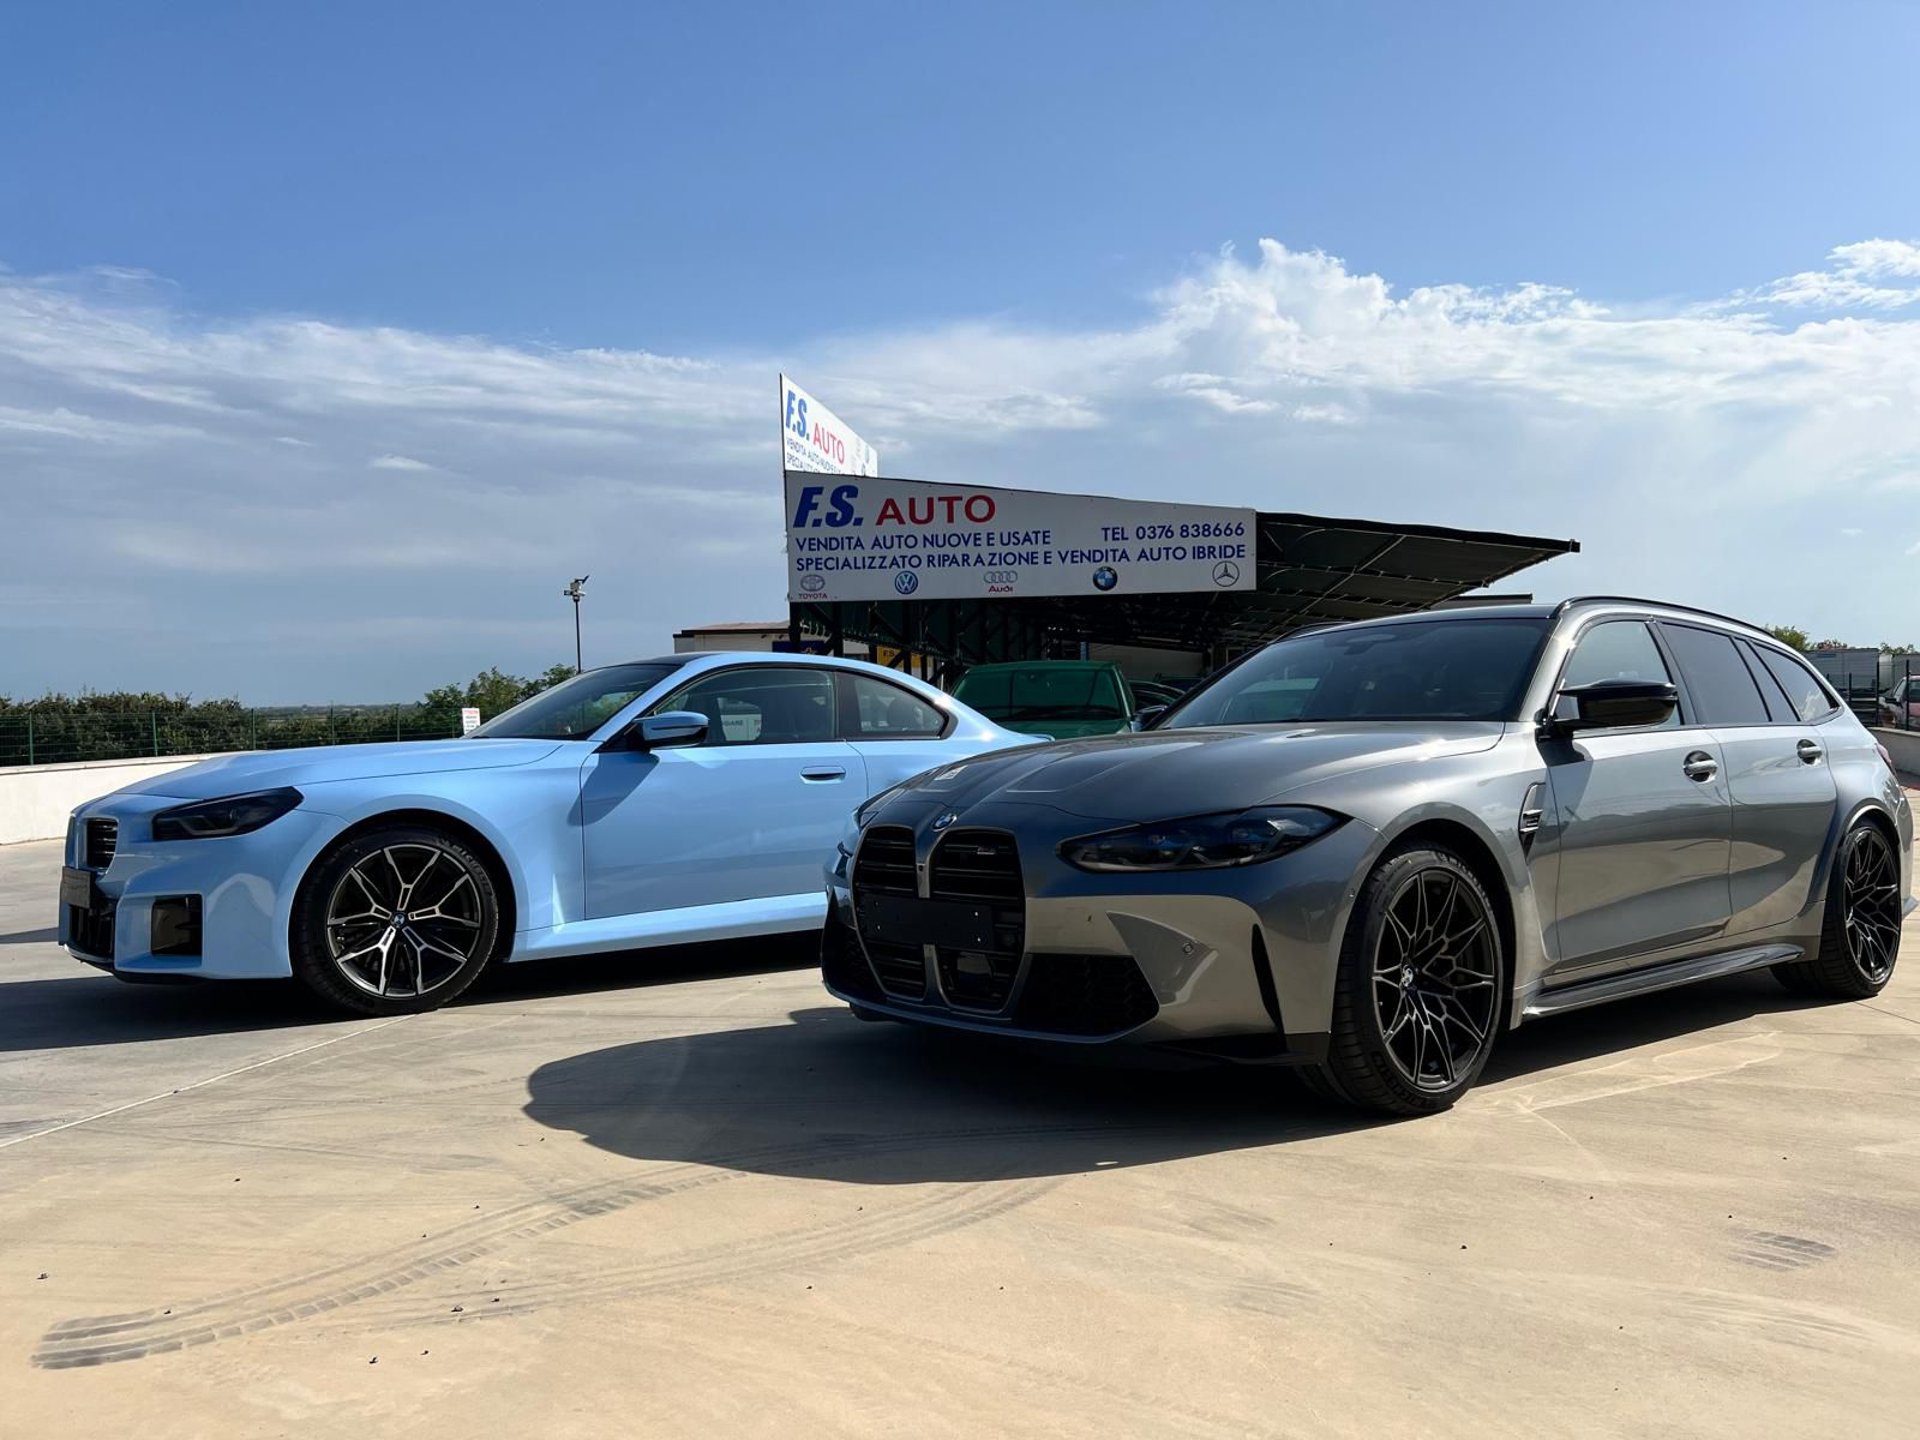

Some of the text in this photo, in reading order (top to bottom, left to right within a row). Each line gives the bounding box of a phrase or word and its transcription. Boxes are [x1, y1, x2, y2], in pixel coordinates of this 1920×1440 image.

[785, 389, 846, 465] F.S. AUTO
[793, 485, 996, 528] F.S. AUTO
[796, 530, 1051, 552] VENDITA AUTO NUOVE E USATE
[1101, 522, 1245, 542] TEL 0376 838666
[796, 544, 1246, 572] SPECIALIZZATO RIPARAZIONE E VENDITA AUTO IBRIDE
[798, 592, 828, 600] TOYOTA
[988, 584, 1014, 593] Audi
